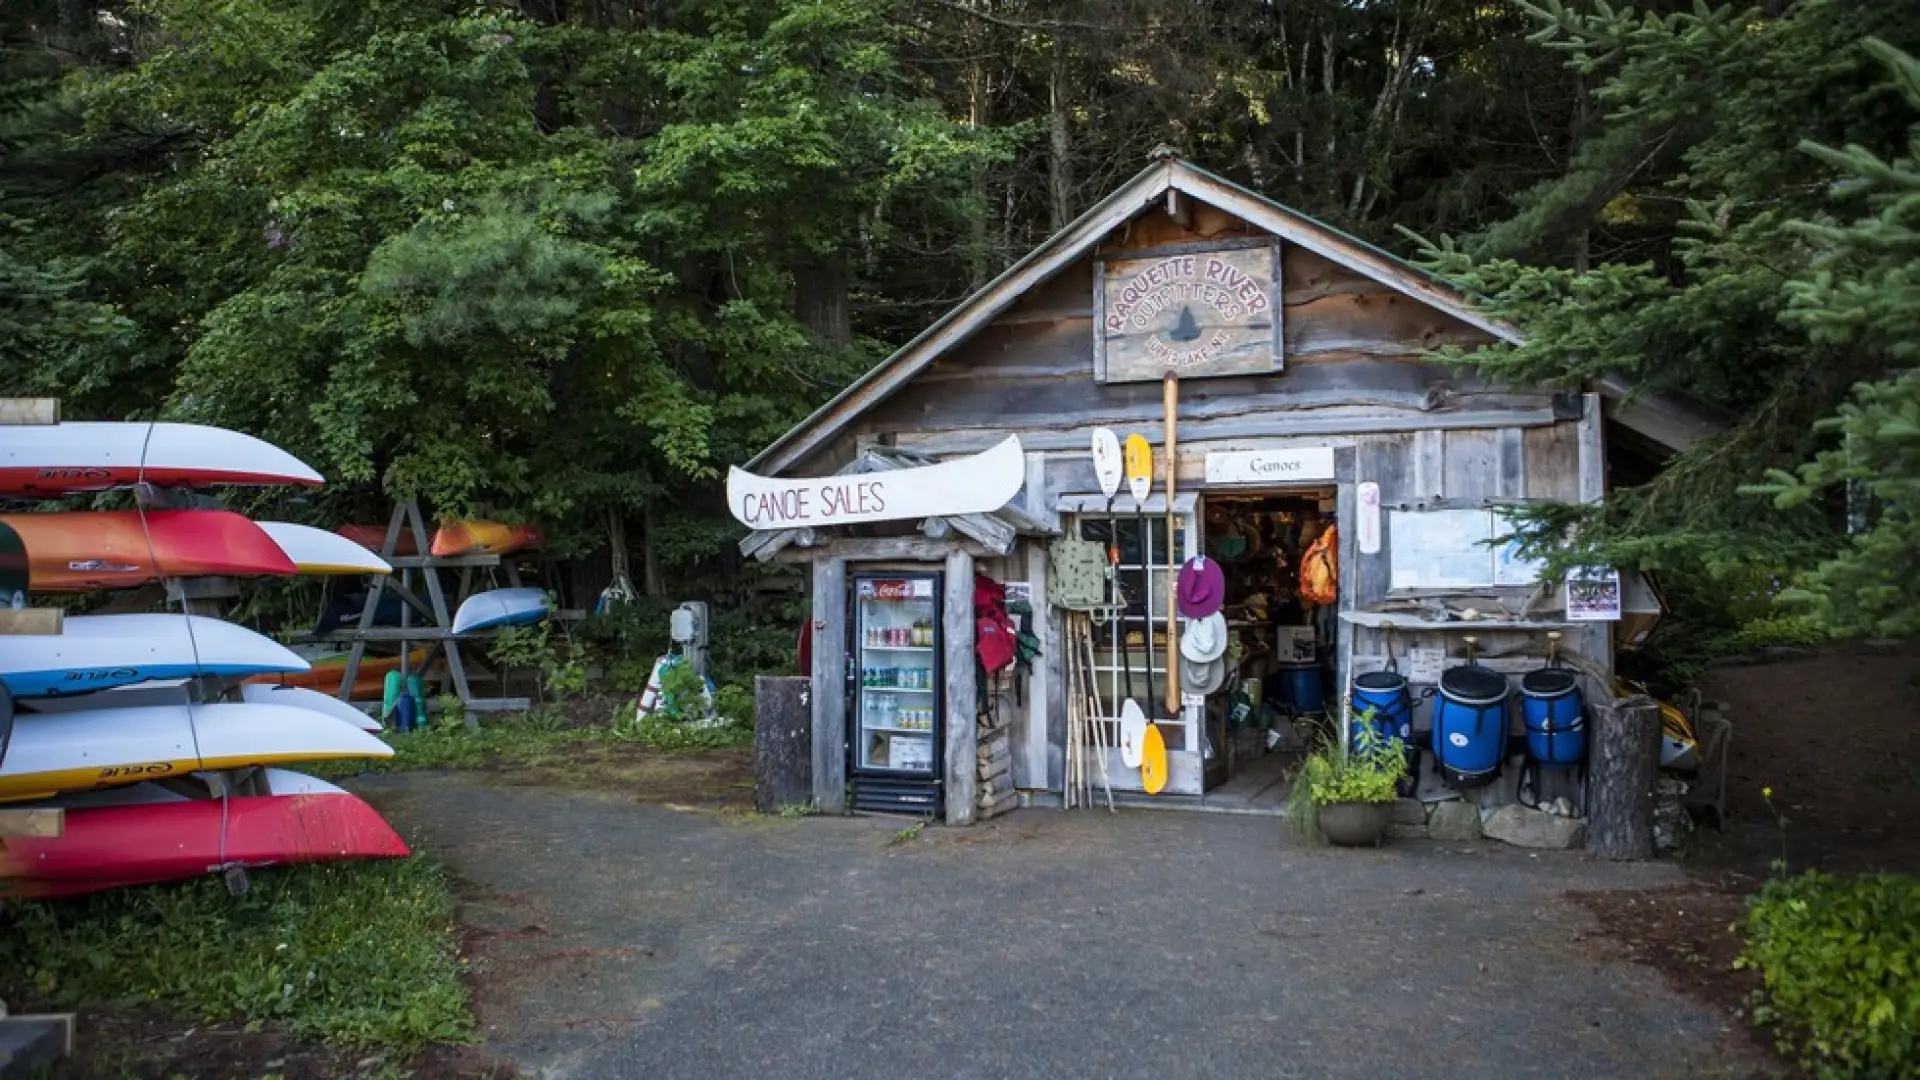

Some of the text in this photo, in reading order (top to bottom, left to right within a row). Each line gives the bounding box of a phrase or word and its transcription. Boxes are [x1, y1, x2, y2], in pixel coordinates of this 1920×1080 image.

[1108, 256, 1268, 332] RAQUETTE RIVER
[1132, 283, 1240, 329] OUTFITTERS
[1249, 458, 1301, 475] Canoes
[743, 482, 885, 522] CANOE SALES
